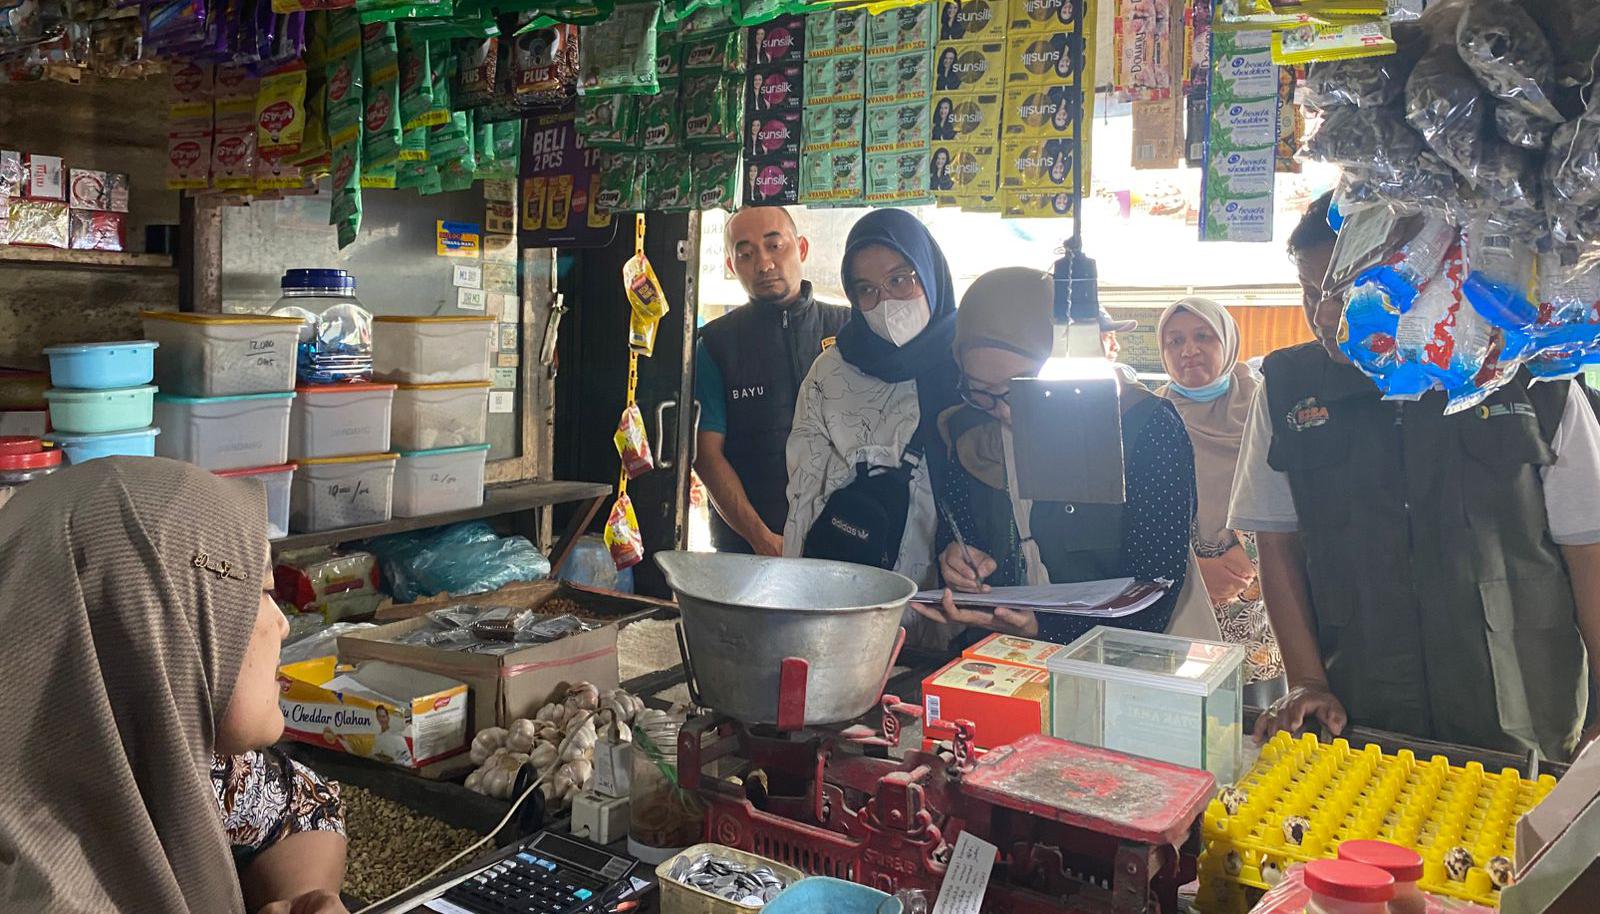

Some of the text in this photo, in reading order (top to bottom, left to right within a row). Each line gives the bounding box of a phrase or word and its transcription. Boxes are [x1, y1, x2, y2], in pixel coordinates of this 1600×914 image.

[762, 35, 795, 48] sunsilk
[1020, 50, 1060, 65] sunsilk
[1130, 32, 1147, 74] Downy
[461, 69, 480, 83] PLUS
[523, 68, 550, 84] PLUS
[1232, 67, 1271, 76] shoulders
[760, 81, 792, 94] sunsilk
[1017, 104, 1057, 118] sunsilk
[688, 117, 709, 130] MILO
[1230, 116, 1268, 125] shoulders
[758, 127, 791, 140] sunsilk
[533, 127, 567, 156] BELI
[1014, 157, 1055, 170] sunsilk
[1227, 165, 1266, 173] shoulders
[756, 174, 788, 186] sunsilk
[601, 190, 620, 201] MILO
[702, 189, 722, 201] MILO
[1226, 213, 1265, 221] shoulders
[732, 385, 764, 400] BAYU
[831, 517, 857, 536] adidas
[292, 704, 333, 725] Cheddar
[334, 710, 372, 728] Olahan
